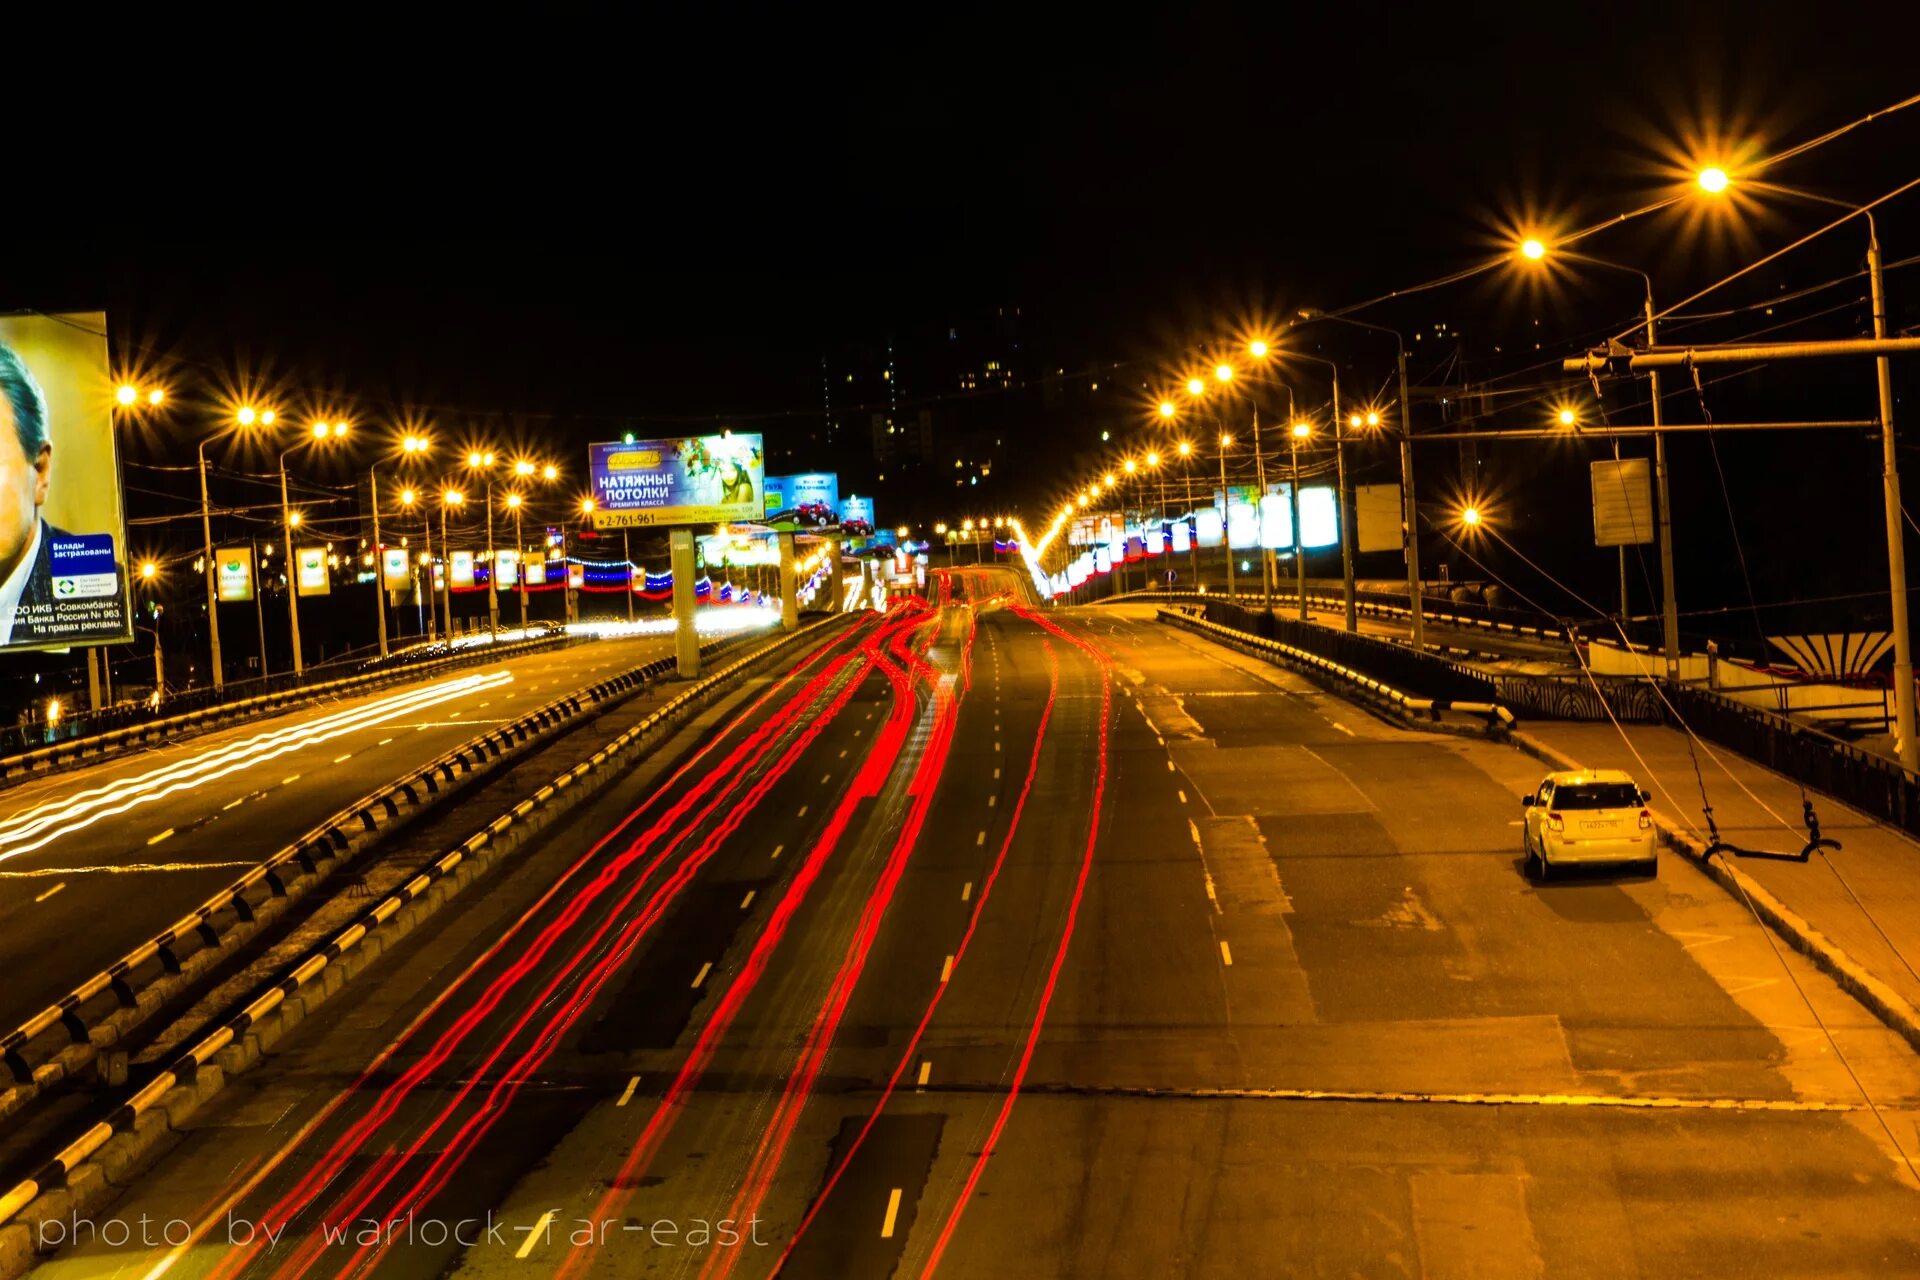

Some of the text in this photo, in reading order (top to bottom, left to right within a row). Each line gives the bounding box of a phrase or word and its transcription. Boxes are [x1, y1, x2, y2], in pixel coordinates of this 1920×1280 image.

[600, 473, 674, 488] НАТЯЖНЫЕ
[606, 486, 669, 501] ПОТОЛКИ
[609, 499, 665, 509] ПРЕМИУМ КЛАССА
[606, 514, 655, 526] 2-761-961
[53, 542, 85, 551] Вклады
[54, 548, 111, 558] застрахованы
[32, 601, 52, 614] ИКБ
[27, 614, 55, 624] Банка
[56, 611, 89, 622] России
[33, 623, 46, 634] На
[48, 621, 80, 634] правах
